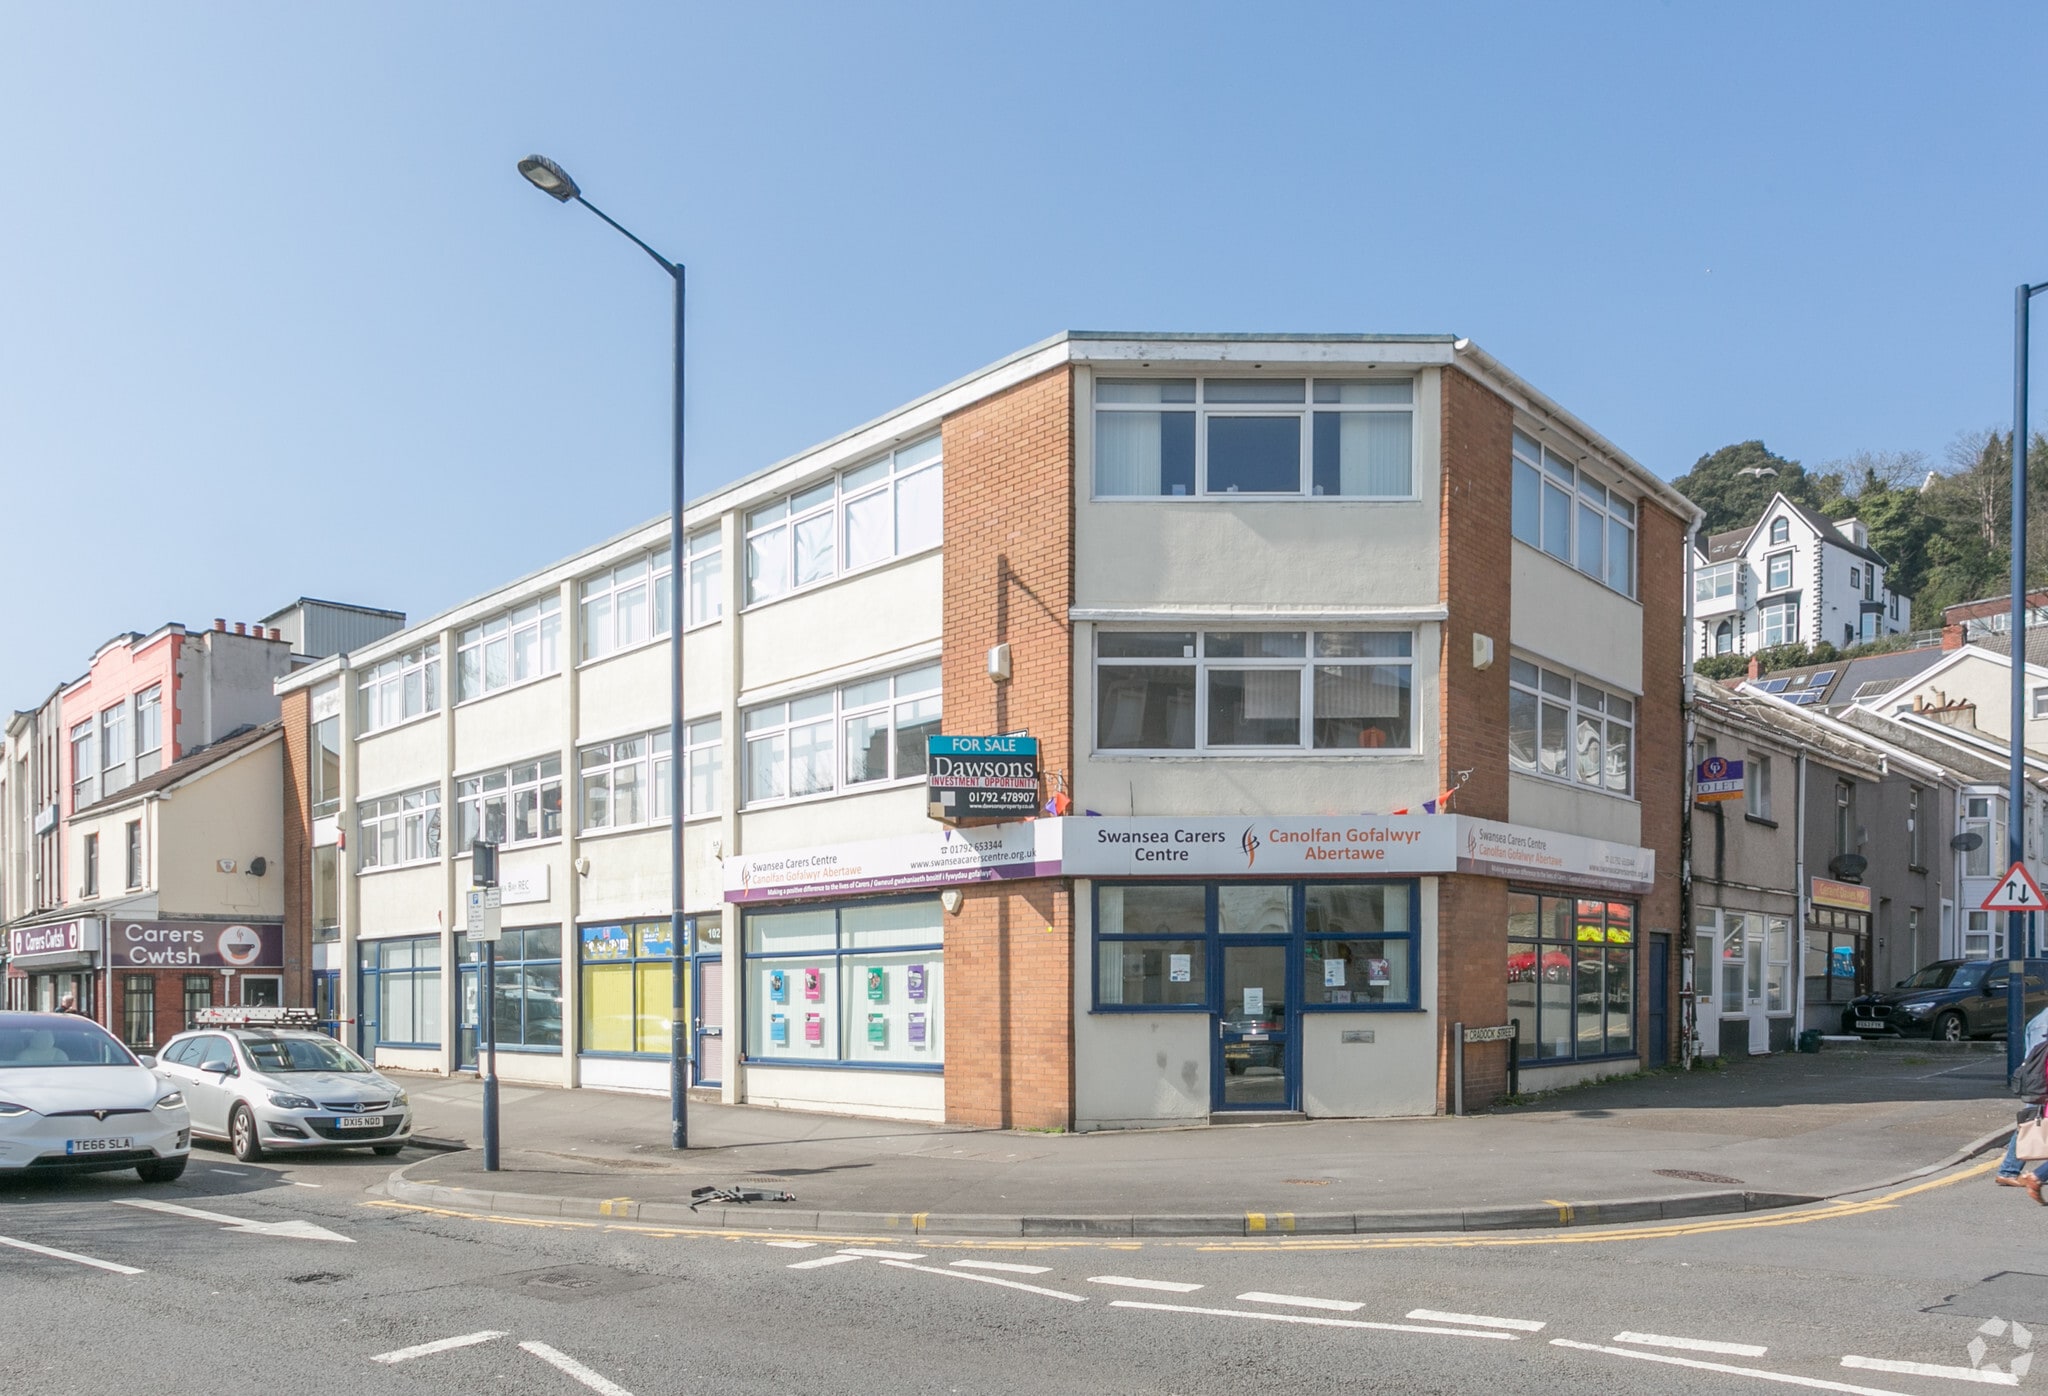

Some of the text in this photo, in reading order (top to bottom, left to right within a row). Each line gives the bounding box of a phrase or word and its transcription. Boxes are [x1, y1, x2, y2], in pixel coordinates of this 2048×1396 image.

[952, 738, 1016, 752] FOR SALE
[934, 756, 1034, 778] Dawsons
[931, 776, 1036, 788] INVESTMENT OPPORTUNITY
[1714, 781, 1737, 791] LET
[969, 792, 1035, 803] 01792 478907
[1098, 829, 1226, 844] Swansea Carers
[1269, 828, 1421, 845] Canolfan Gofalwyr
[1479, 828, 1547, 850] Swansea Carers Centre
[950, 840, 1002, 854] 01792 653344
[1304, 846, 1385, 860] Abertawe
[910, 847, 1037, 869] www.swanseacarerscentre.org.uk
[1135, 848, 1189, 862] Centre
[752, 854, 837, 872] Swansea Carers Centre
[752, 865, 862, 885] Canolfan Gofalwyr Abertawe
[786, 887, 802, 895] positive
[803, 884, 824, 893] difference
[855, 880, 870, 888] Carers
[874, 878, 894, 887] Gwneud
[25, 929, 64, 951] Carers Cwtsh
[125, 924, 204, 943] Carers
[707, 928, 720, 939] 102
[129, 946, 201, 965] Cwtsh
[1470, 1027, 1514, 1040] CRADOCK STREET
[344, 1118, 362, 1126] DX15
[75, 1139, 130, 1150] TE66 SLA
